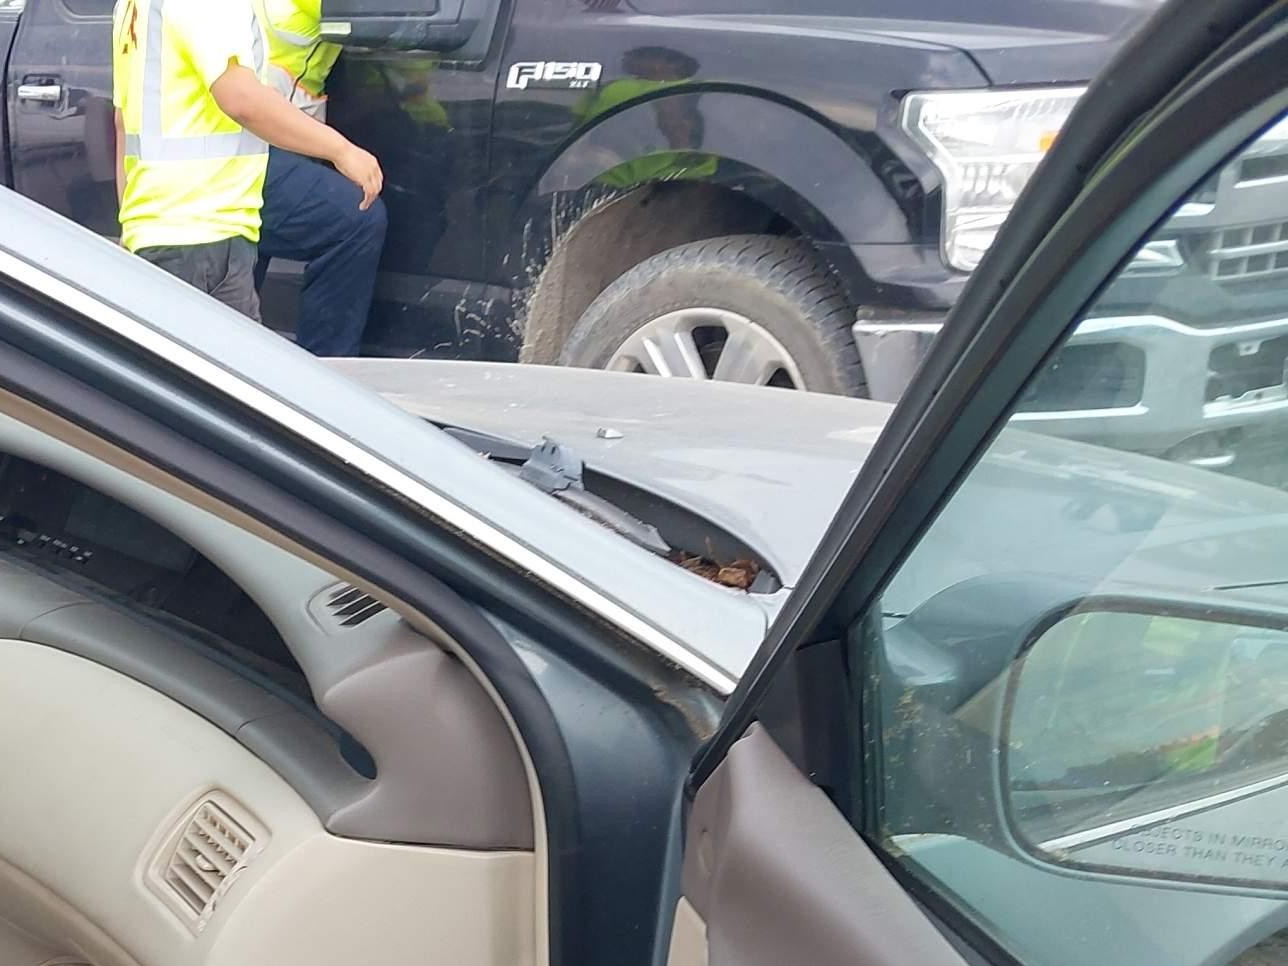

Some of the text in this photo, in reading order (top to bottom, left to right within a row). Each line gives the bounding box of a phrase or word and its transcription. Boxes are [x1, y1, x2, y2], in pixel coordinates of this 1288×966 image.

[1208, 832, 1226, 845] IN
[1112, 839, 1177, 855] CLOSER
[1183, 846, 1226, 861] THAN
[1234, 851, 1277, 866] THEY
